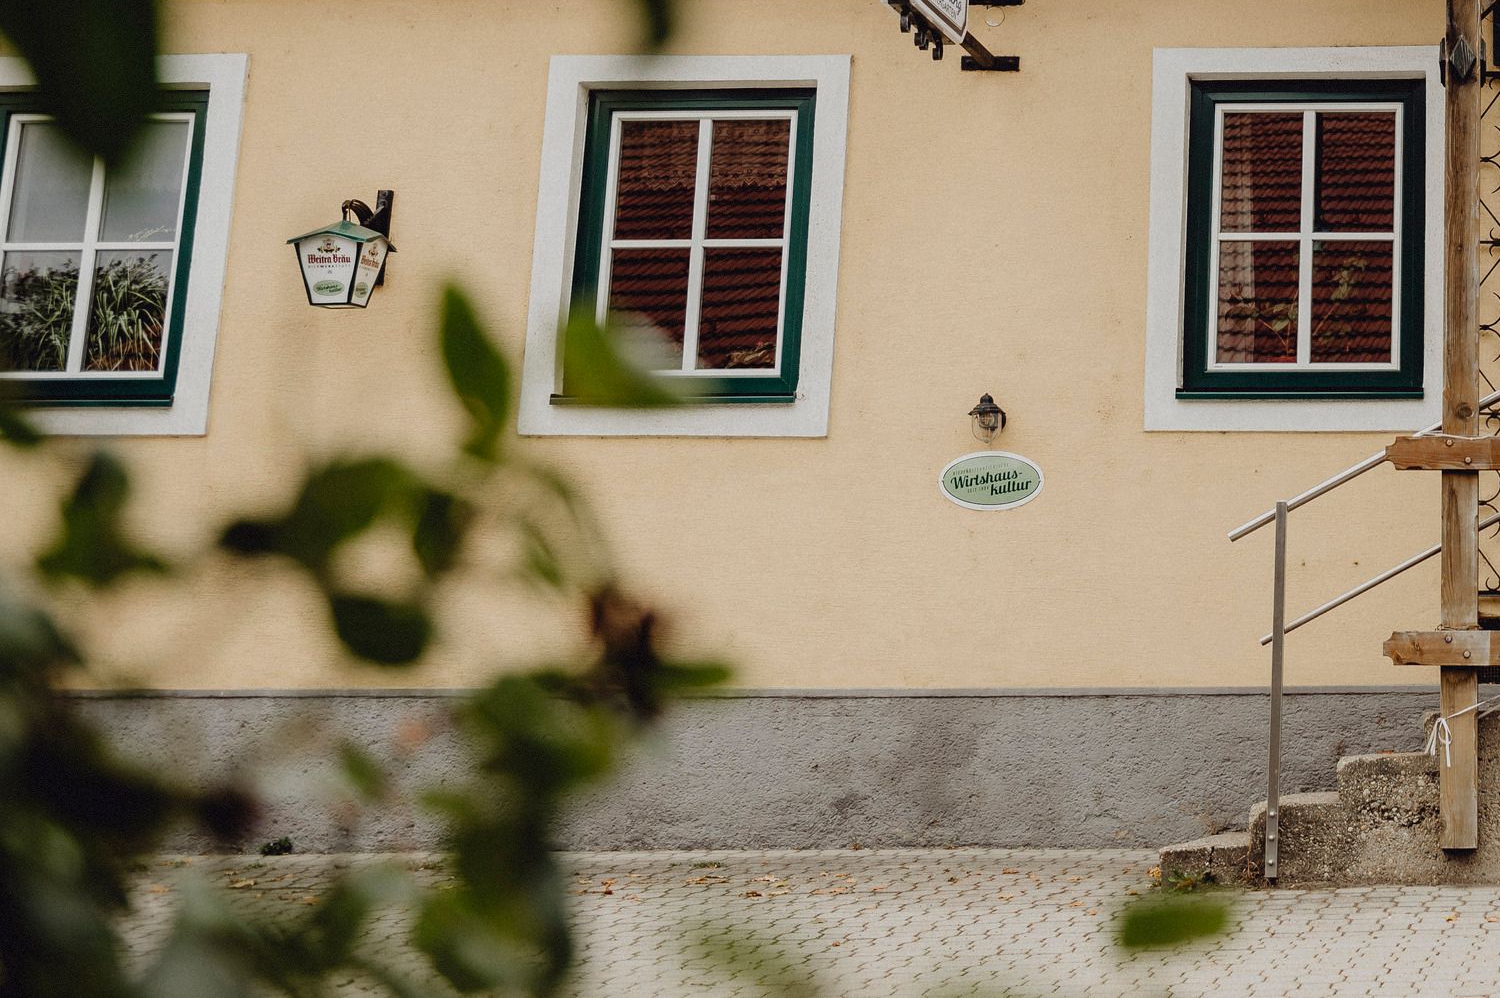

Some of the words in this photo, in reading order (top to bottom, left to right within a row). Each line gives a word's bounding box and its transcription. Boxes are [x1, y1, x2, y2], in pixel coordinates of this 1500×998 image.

[307, 253, 332, 264] Weitra
[950, 470, 1022, 490] Wirtshaus-
[990, 480, 1032, 496] kultur
